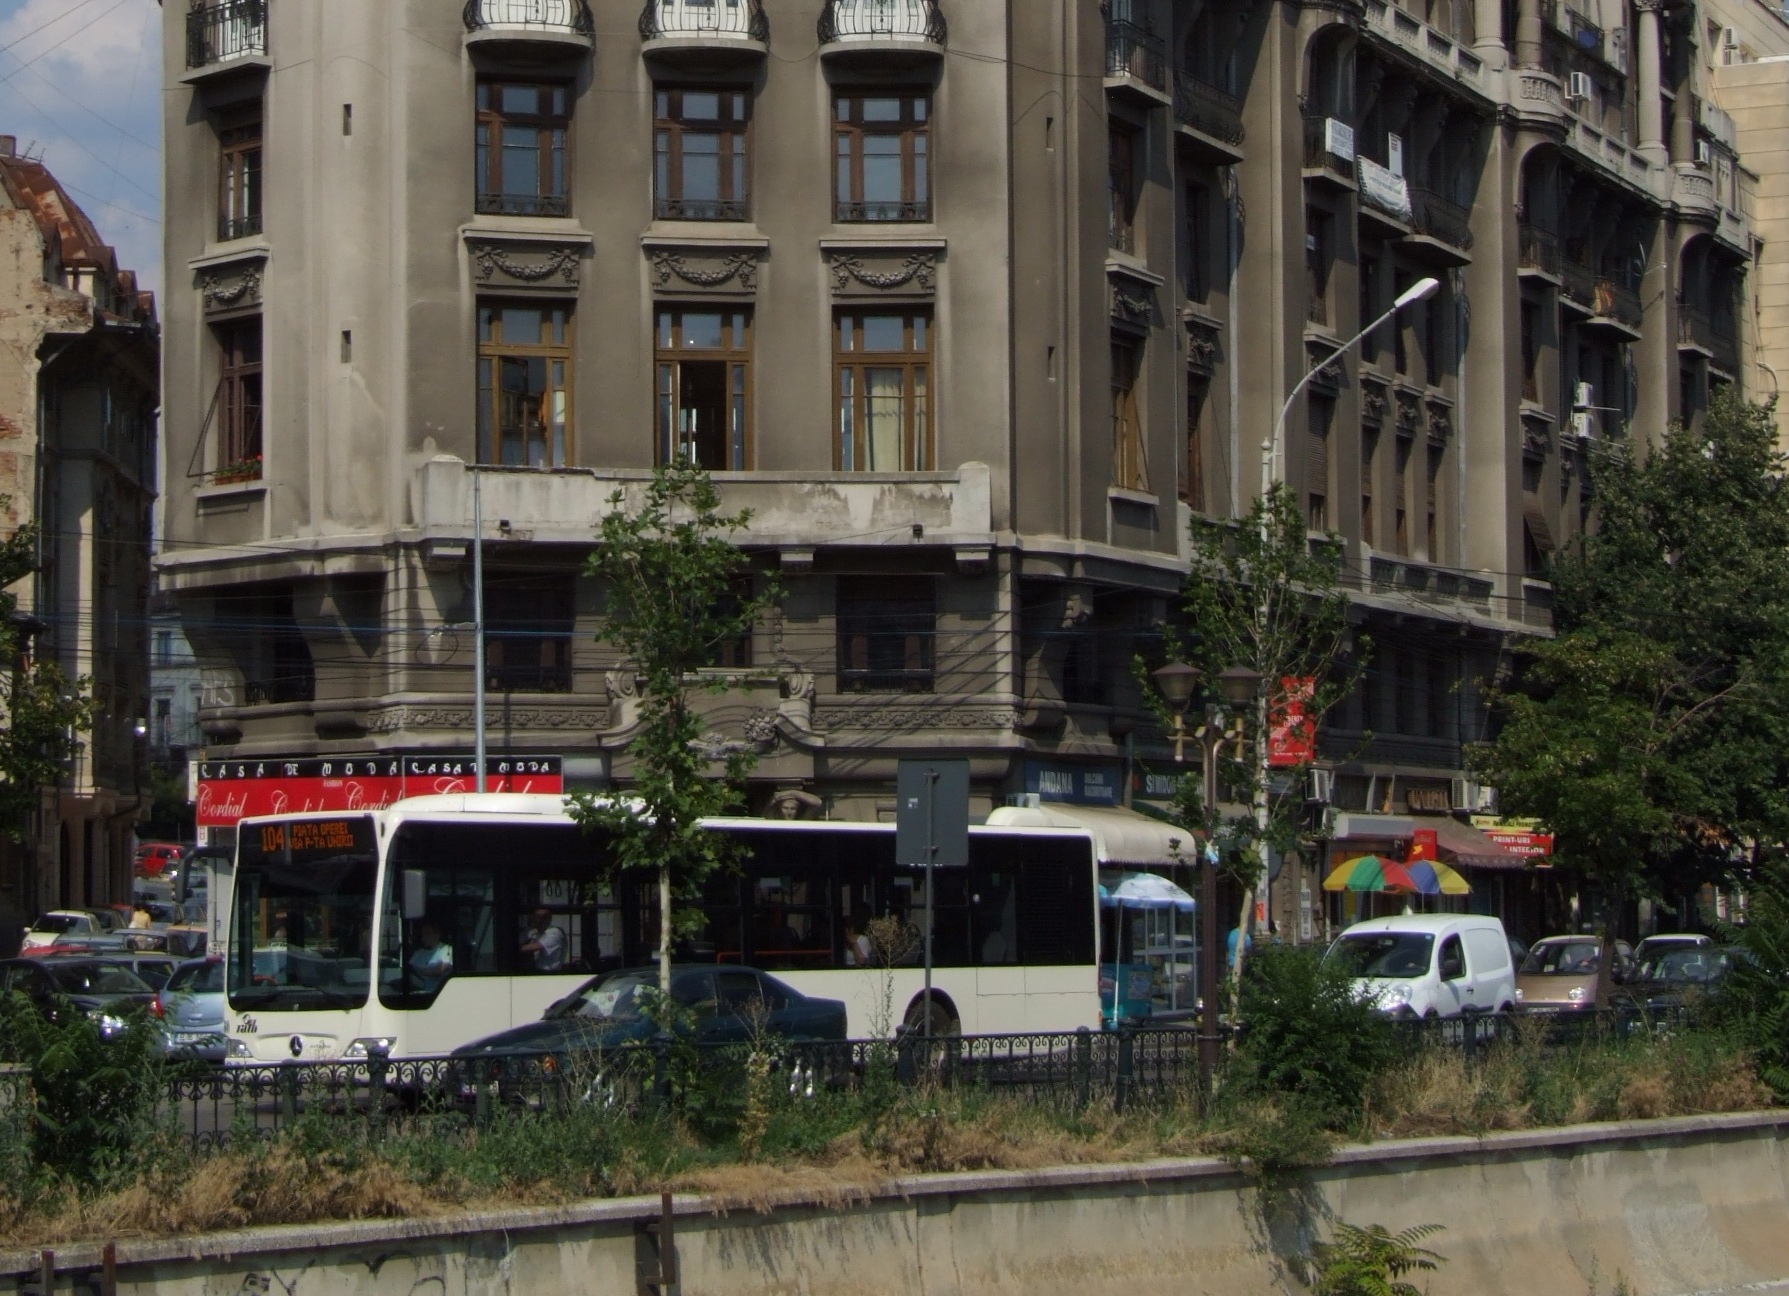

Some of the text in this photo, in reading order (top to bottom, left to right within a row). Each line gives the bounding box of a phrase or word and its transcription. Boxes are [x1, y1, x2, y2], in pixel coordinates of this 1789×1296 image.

[201, 761, 398, 779] CASA DE MODA
[412, 762, 462, 774] CASA
[499, 761, 550, 773] MODA
[199, 783, 248, 817] Cordial
[262, 826, 285, 852] 104
